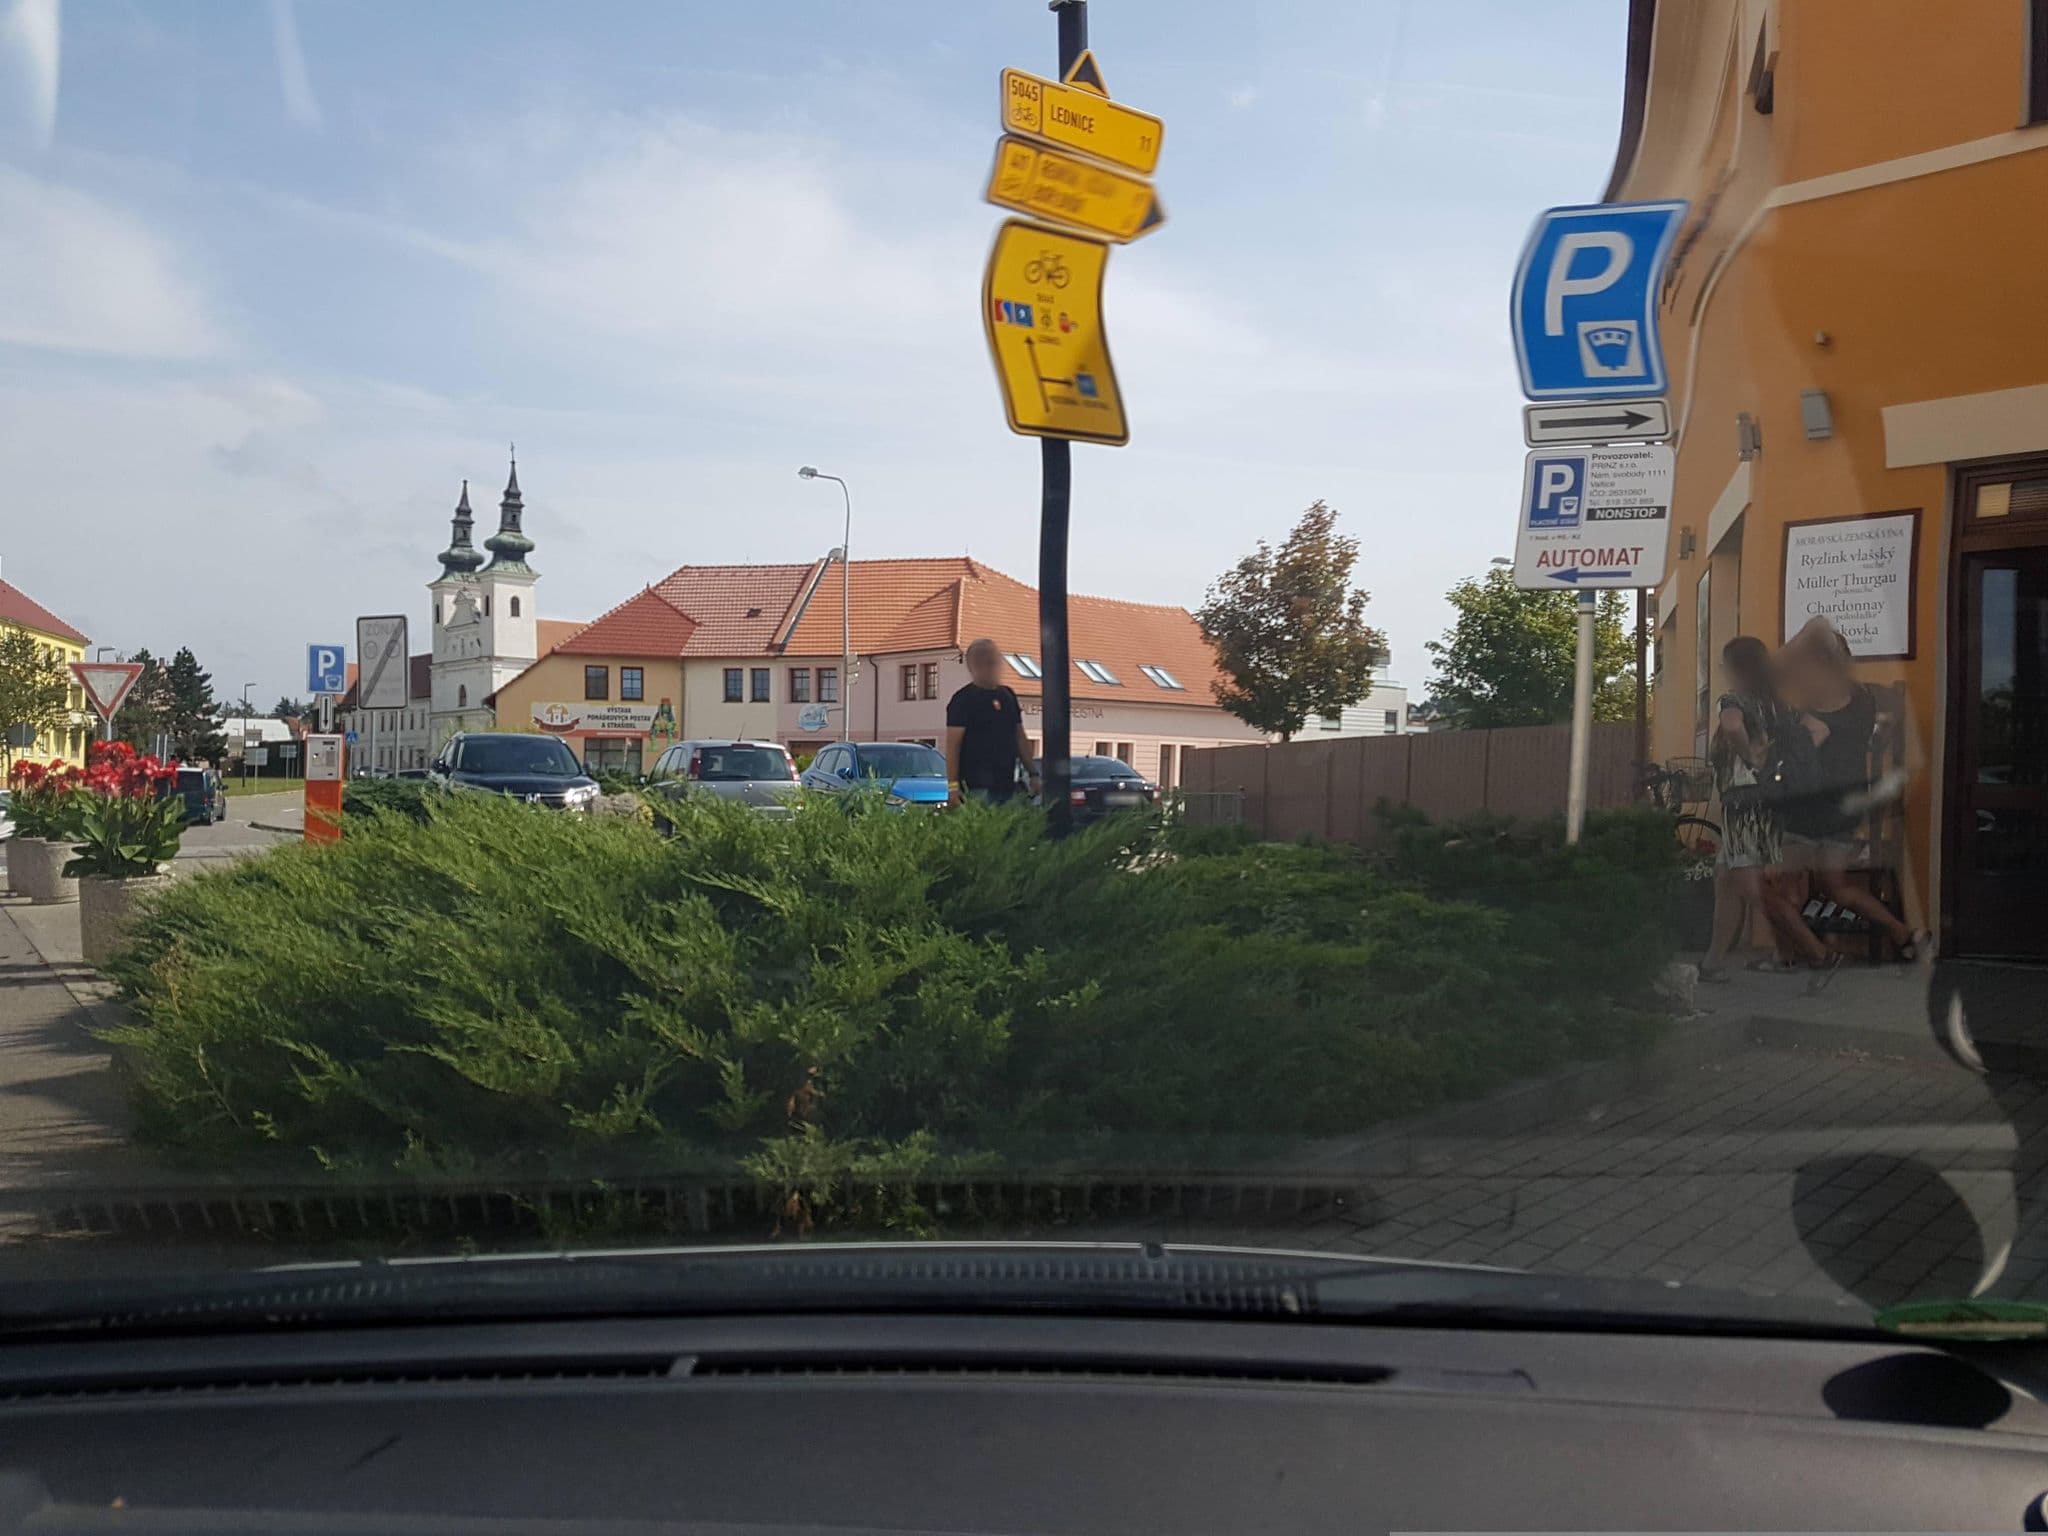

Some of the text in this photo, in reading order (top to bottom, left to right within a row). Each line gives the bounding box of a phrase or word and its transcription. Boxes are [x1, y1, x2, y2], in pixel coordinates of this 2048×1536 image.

[1011, 79, 1039, 102] 5045
[1050, 104, 1095, 133] LEDNICE
[1544, 231, 1634, 336] P
[1592, 451, 1654, 461] Provozovatel:
[1538, 464, 1575, 510] P
[1595, 508, 1658, 519] NONSTOP
[1536, 548, 1644, 568] AUTOMAT
[1801, 546, 1896, 569] Ryzlink vlašský
[1798, 573, 1897, 590] Müller Thurgau
[1806, 600, 1885, 615] Chardonnay
[1836, 622, 1879, 637] kovka
[318, 650, 336, 677] P
